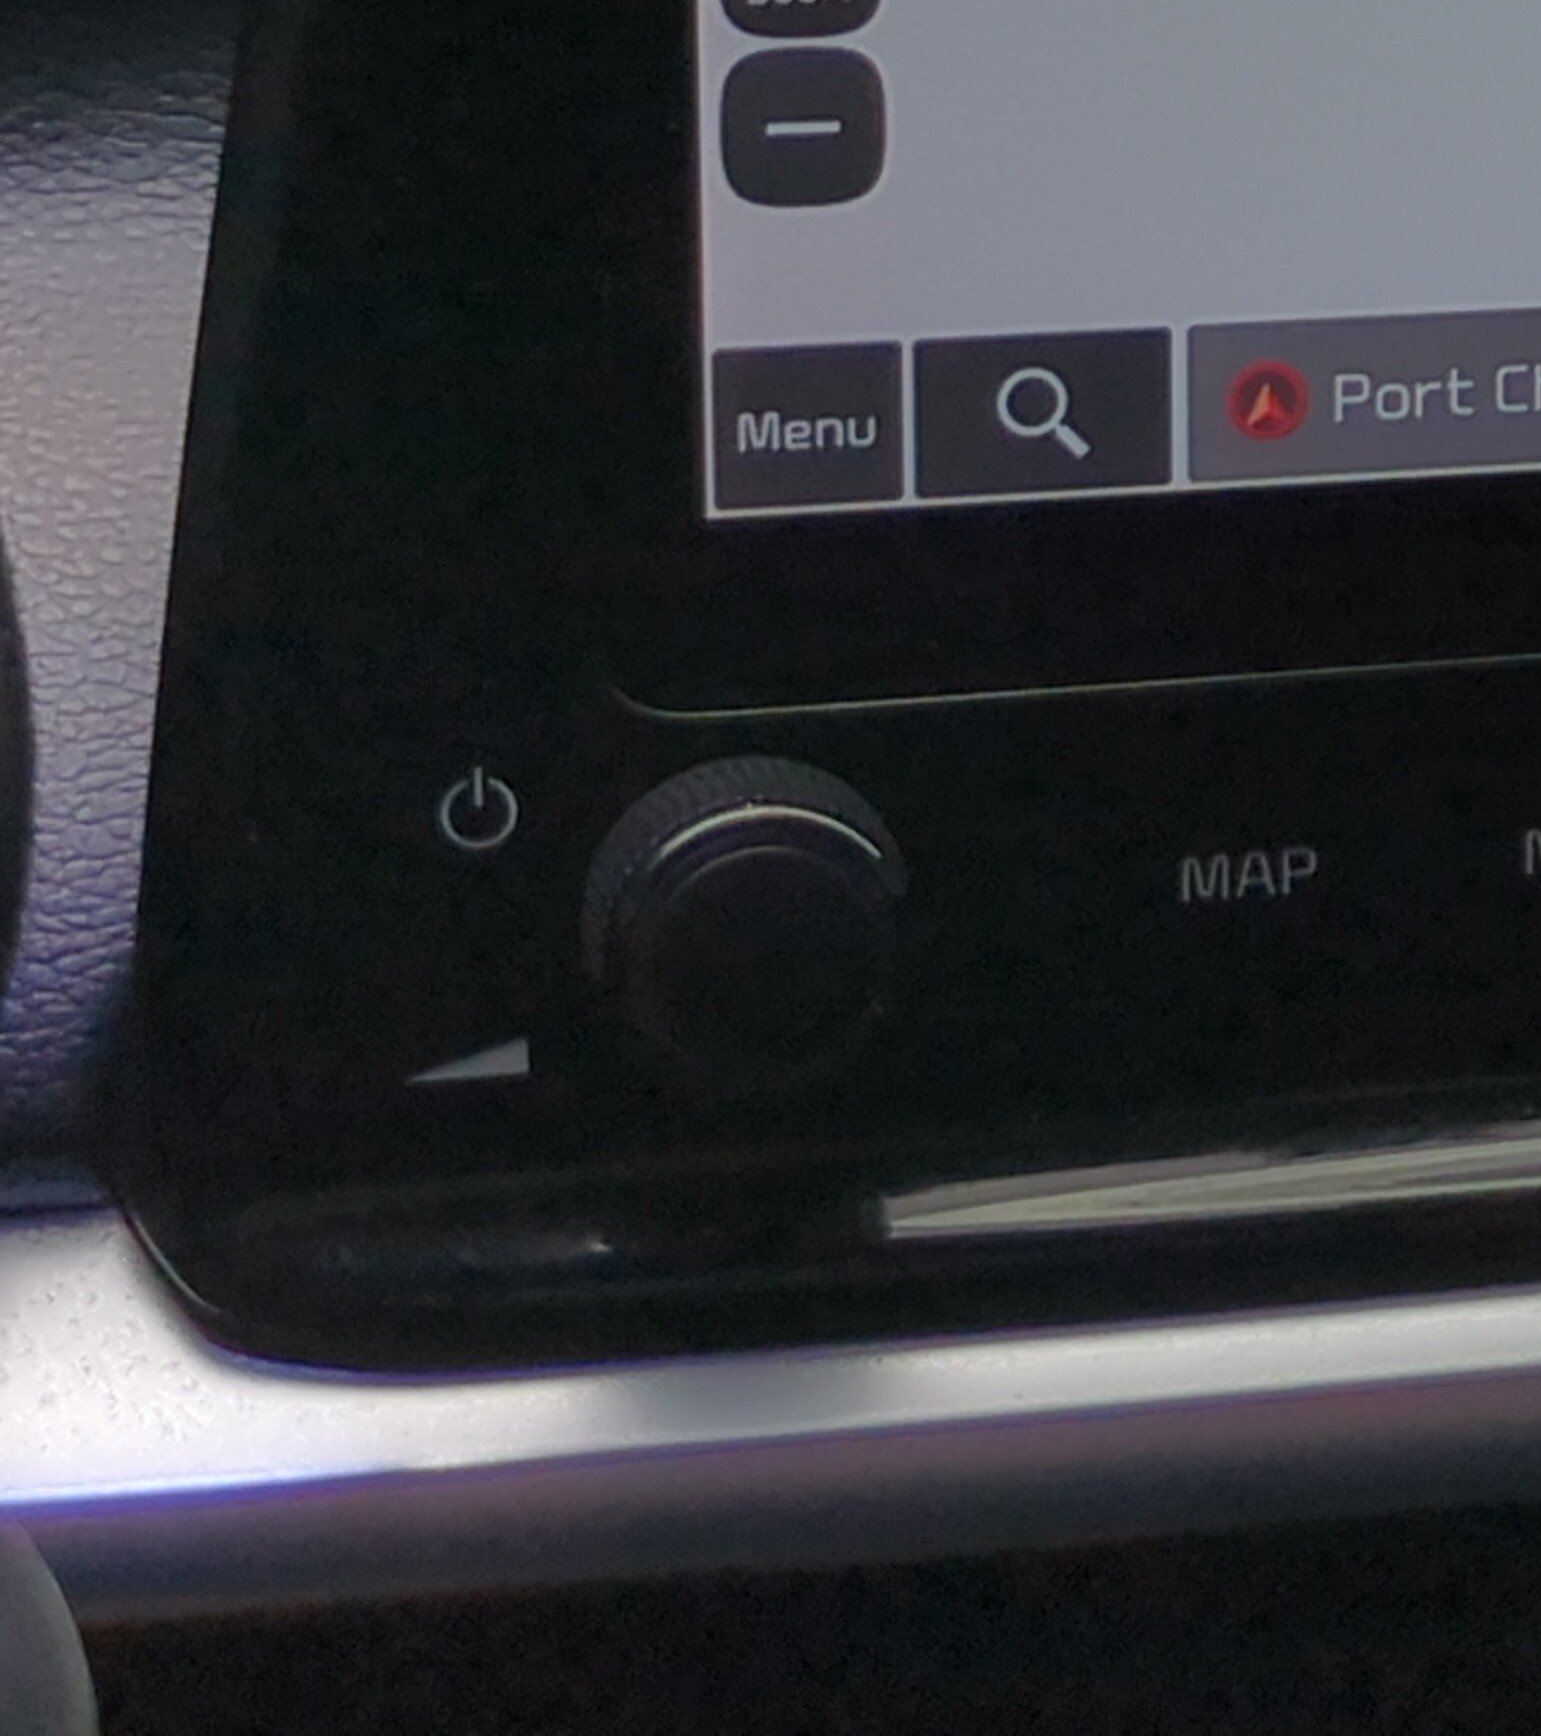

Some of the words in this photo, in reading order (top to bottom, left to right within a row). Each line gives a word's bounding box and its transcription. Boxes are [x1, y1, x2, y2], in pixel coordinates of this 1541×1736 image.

[1331, 371, 1474, 424] Port
[737, 408, 876, 455] Menu
[1179, 846, 1317, 903] MAP
